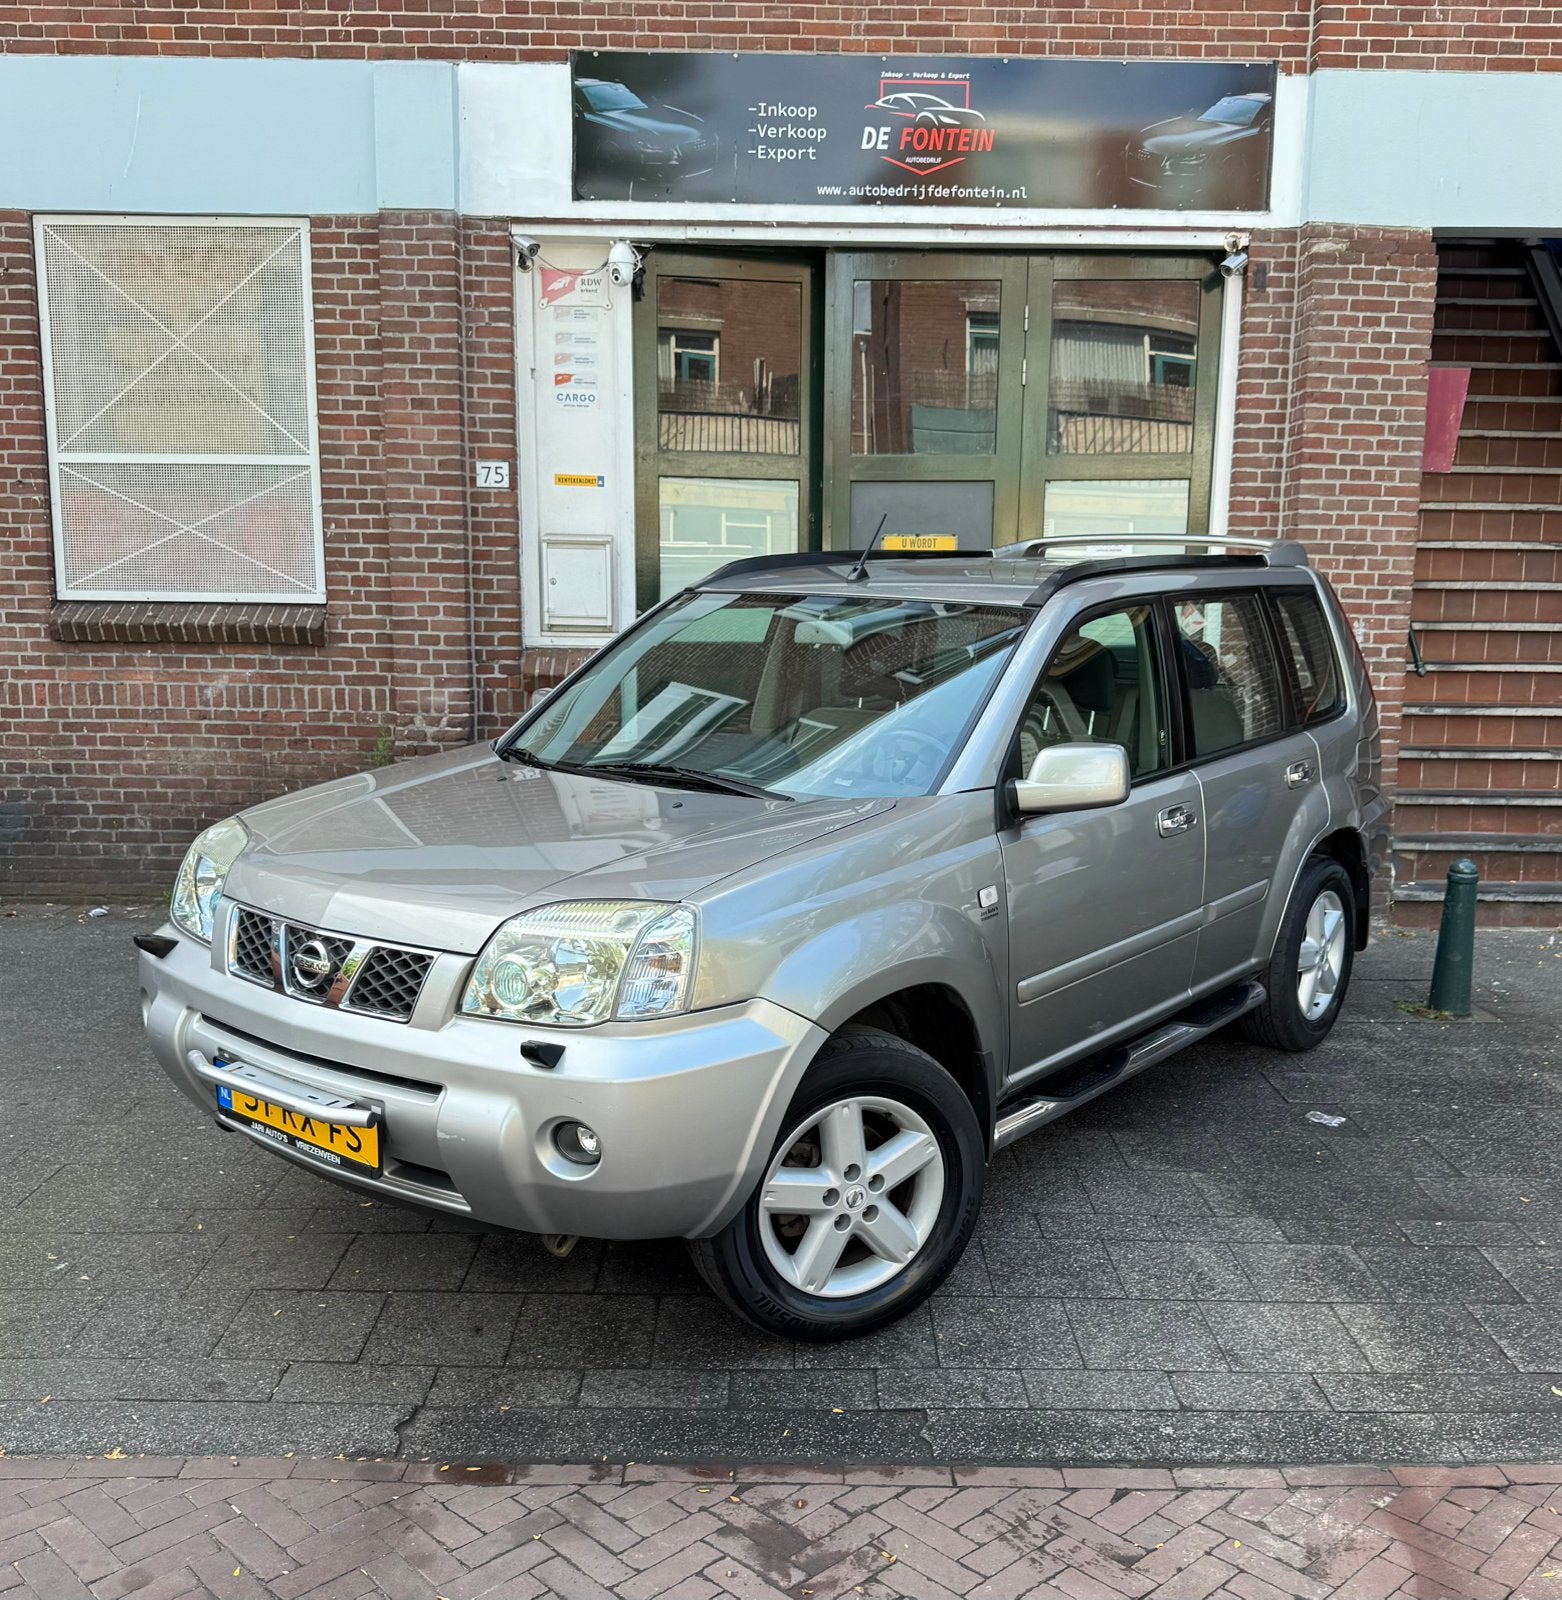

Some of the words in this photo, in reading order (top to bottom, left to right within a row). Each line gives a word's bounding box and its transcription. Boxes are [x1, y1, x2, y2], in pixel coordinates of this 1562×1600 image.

[880, 71, 903, 79] Inkoop
[948, 72, 970, 80] Export
[861, 126, 891, 150] DE
[899, 128, 995, 152] FONTEIN
[817, 185, 1028, 200] www.autobedrijfdefontein.nl
[580, 278, 603, 287] RDW
[556, 393, 596, 402] CARGO
[481, 466, 505, 484] 75
[901, 538, 908, 549] U
[909, 538, 938, 549] WORDT
[220, 1087, 231, 1101] NL
[265, 1127, 289, 1144] AUTO'S
[295, 1139, 341, 1165] VRIEZENVEEN
